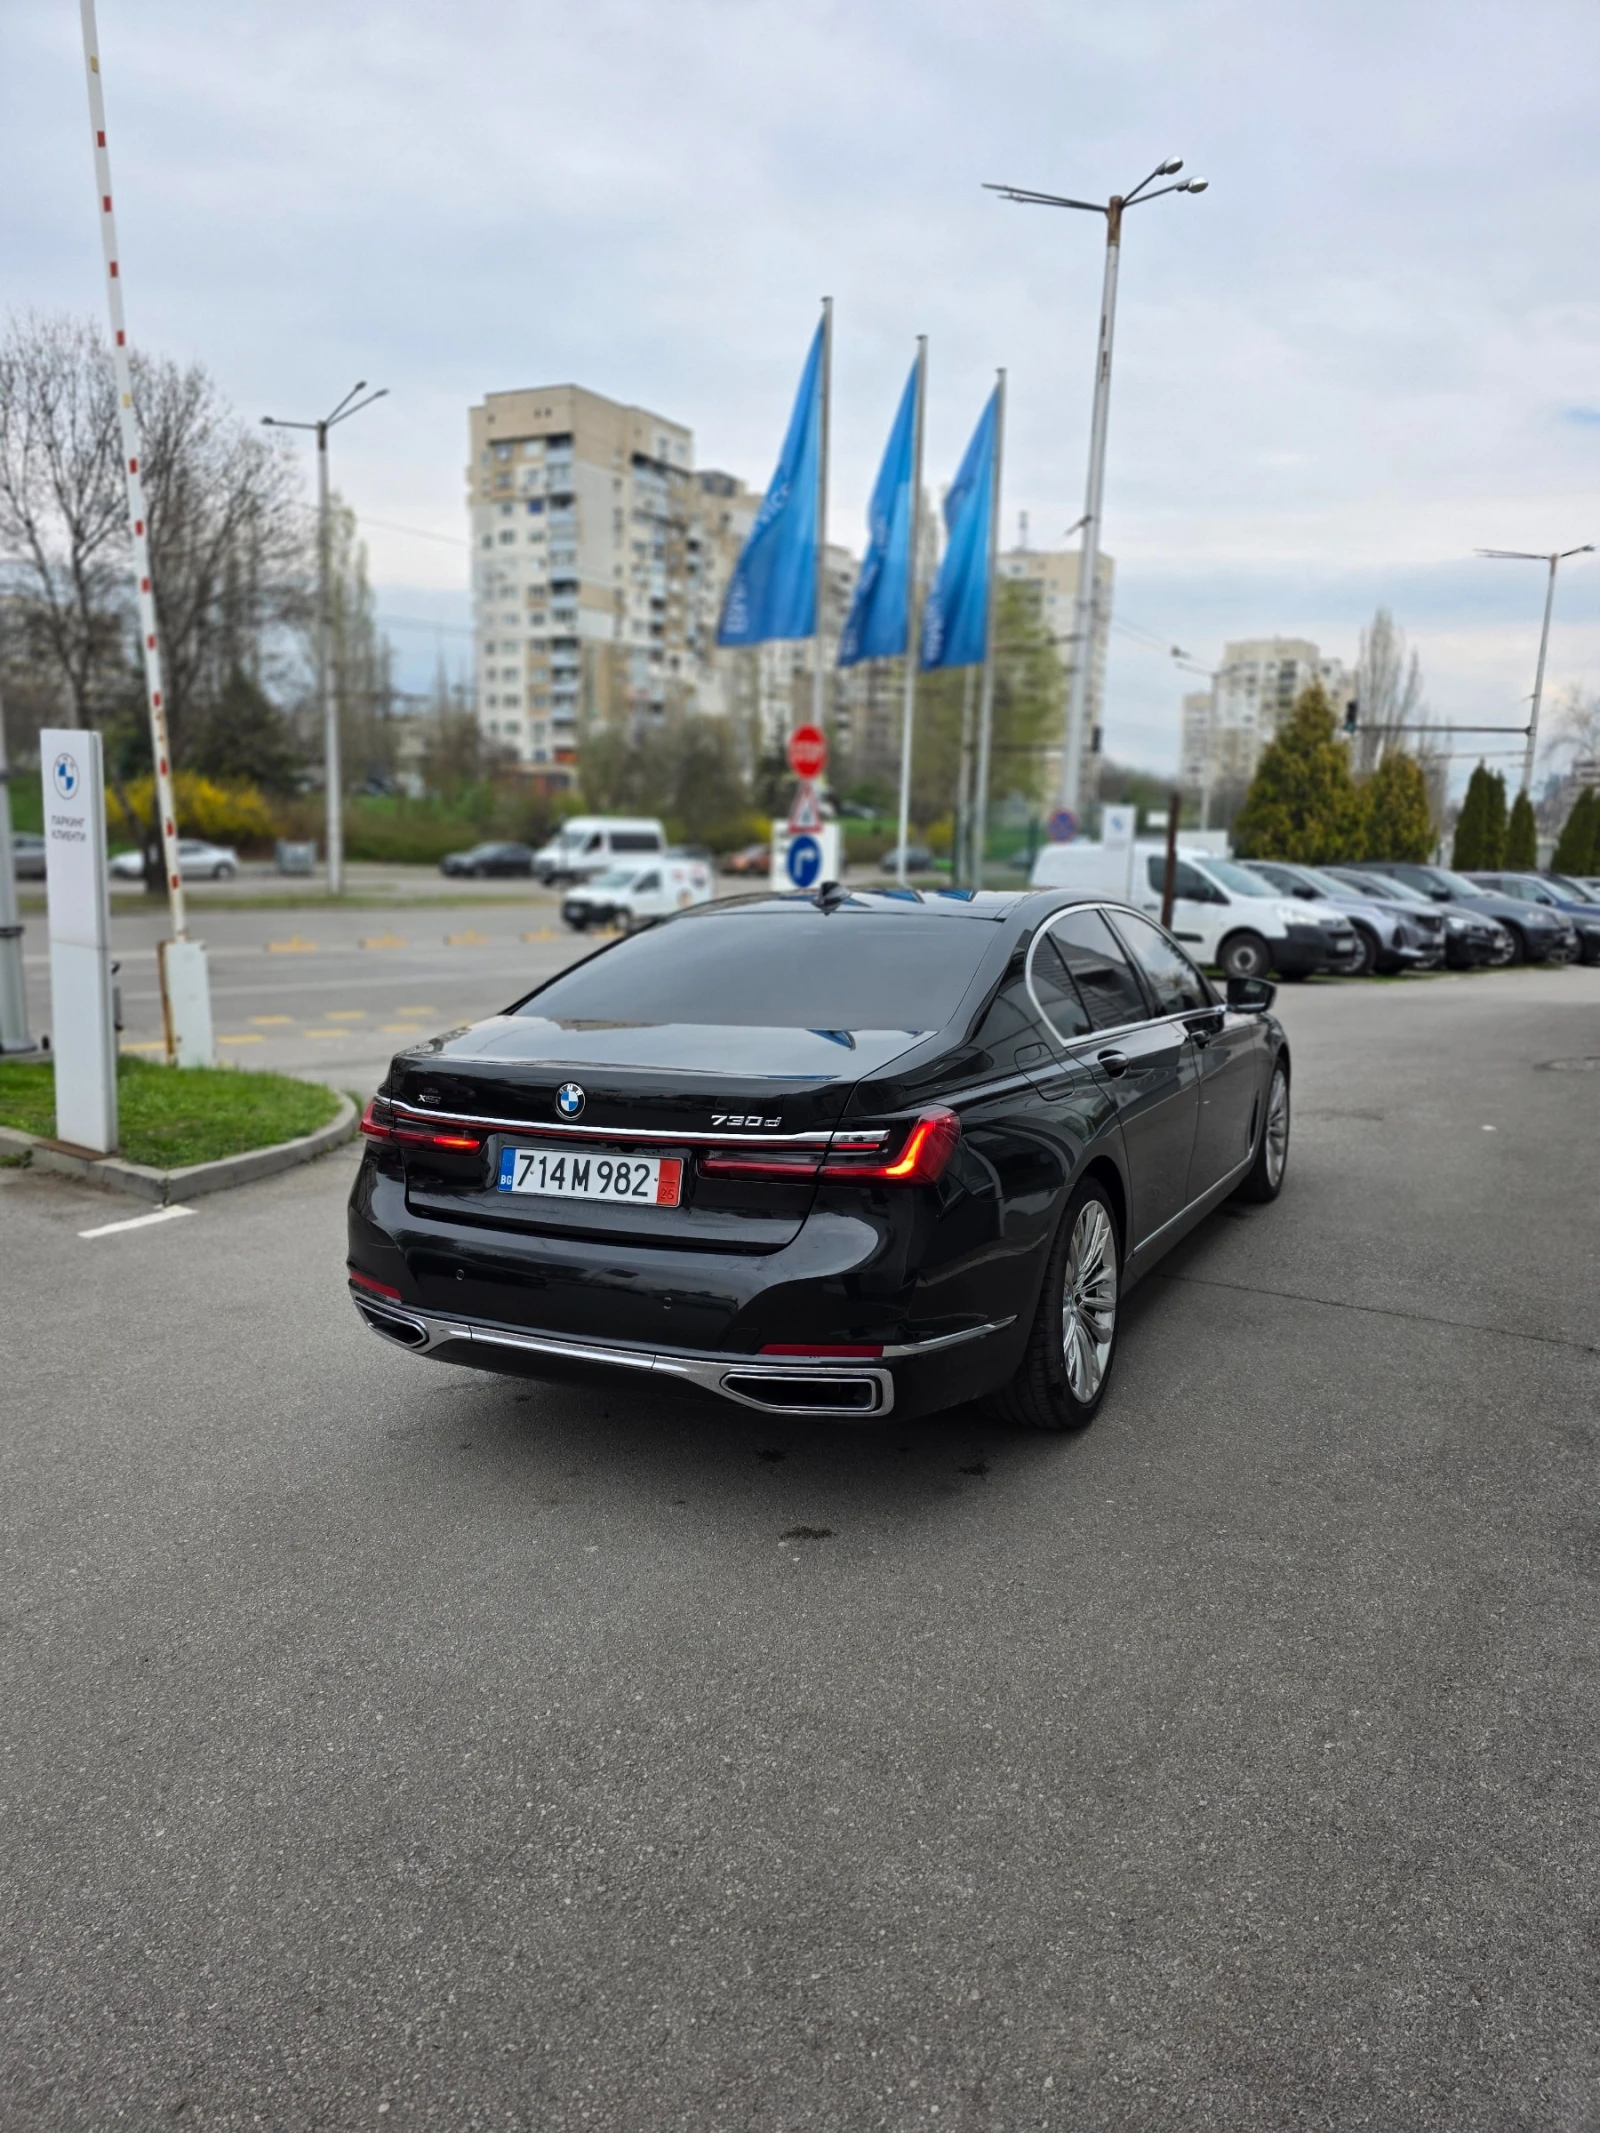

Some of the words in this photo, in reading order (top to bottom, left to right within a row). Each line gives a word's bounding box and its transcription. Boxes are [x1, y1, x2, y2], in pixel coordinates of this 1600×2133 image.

[711, 1115, 782, 1127] 730d
[500, 1174, 512, 1186] BG
[659, 1187, 675, 1200] 25
